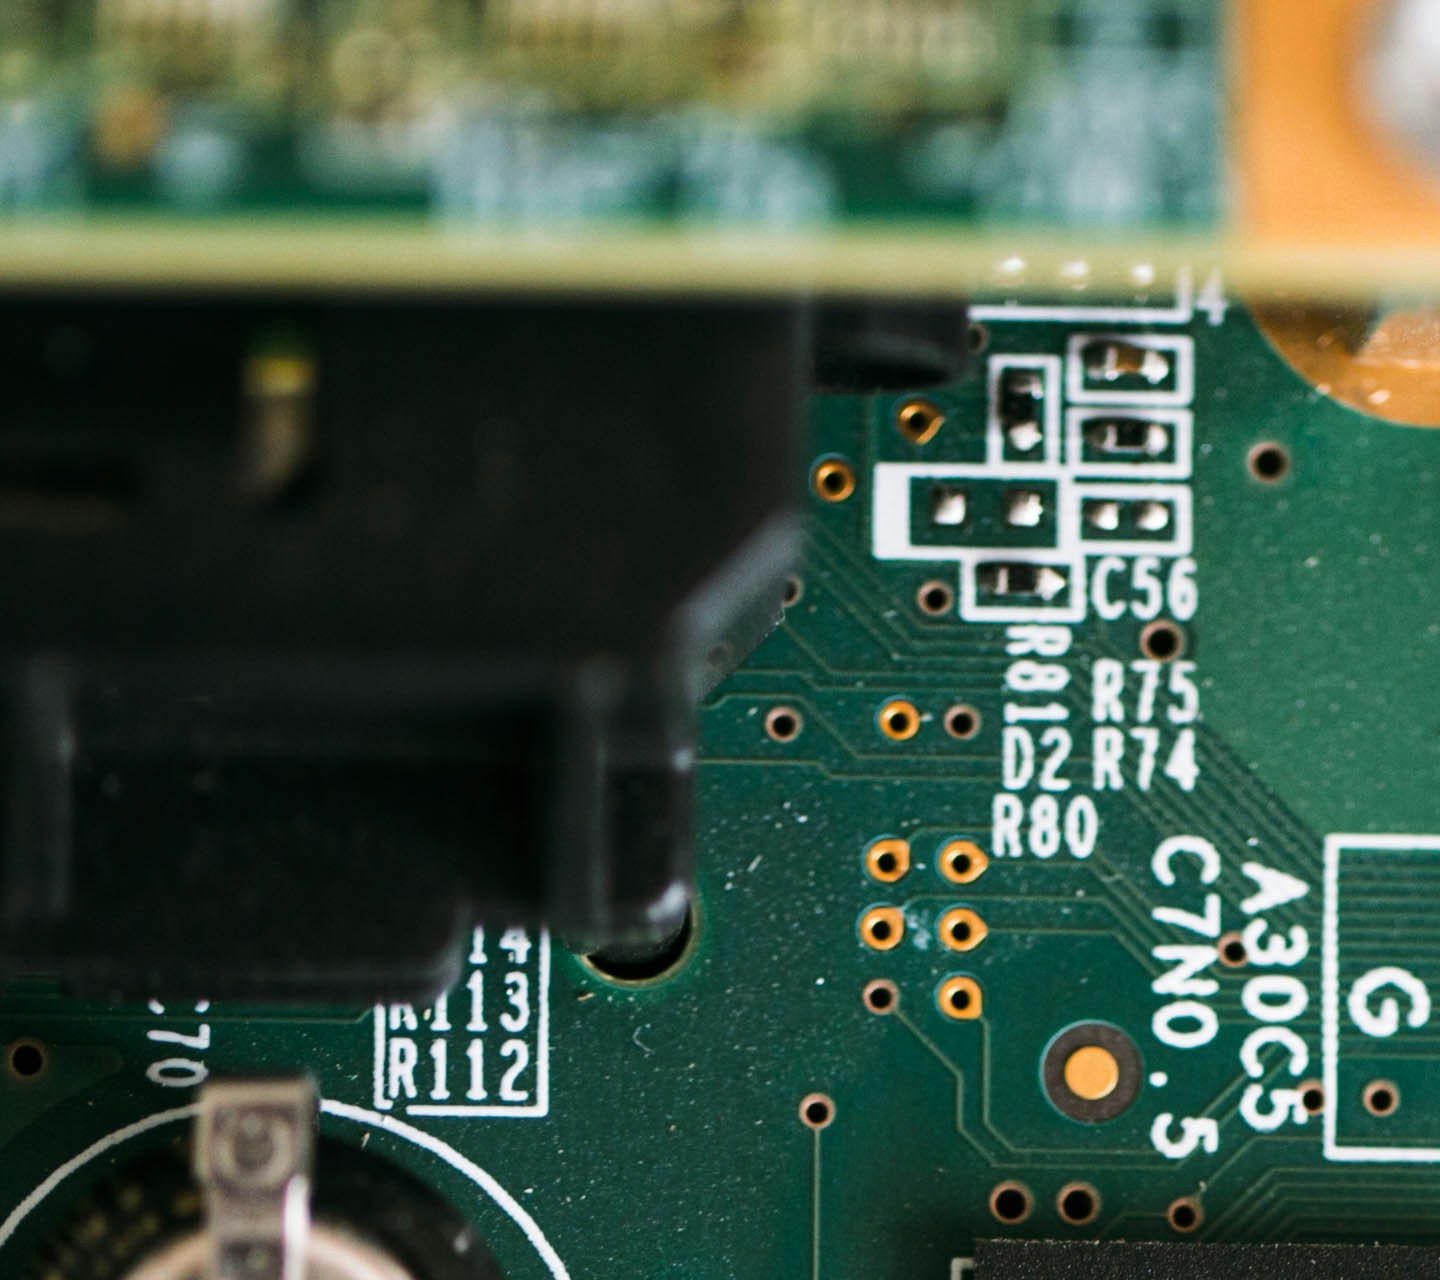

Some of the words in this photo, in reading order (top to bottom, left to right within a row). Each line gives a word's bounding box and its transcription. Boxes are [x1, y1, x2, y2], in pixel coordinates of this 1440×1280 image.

[1090, 558, 1197, 620] C56
[1004, 626, 1071, 722] R81
[1092, 661, 1200, 724] R75
[1001, 728, 1071, 791] D2
[1092, 728, 1200, 791] R74
[992, 796, 1098, 858] R80
[1348, 967, 1430, 1038] G
[390, 1038, 530, 1101] R112
